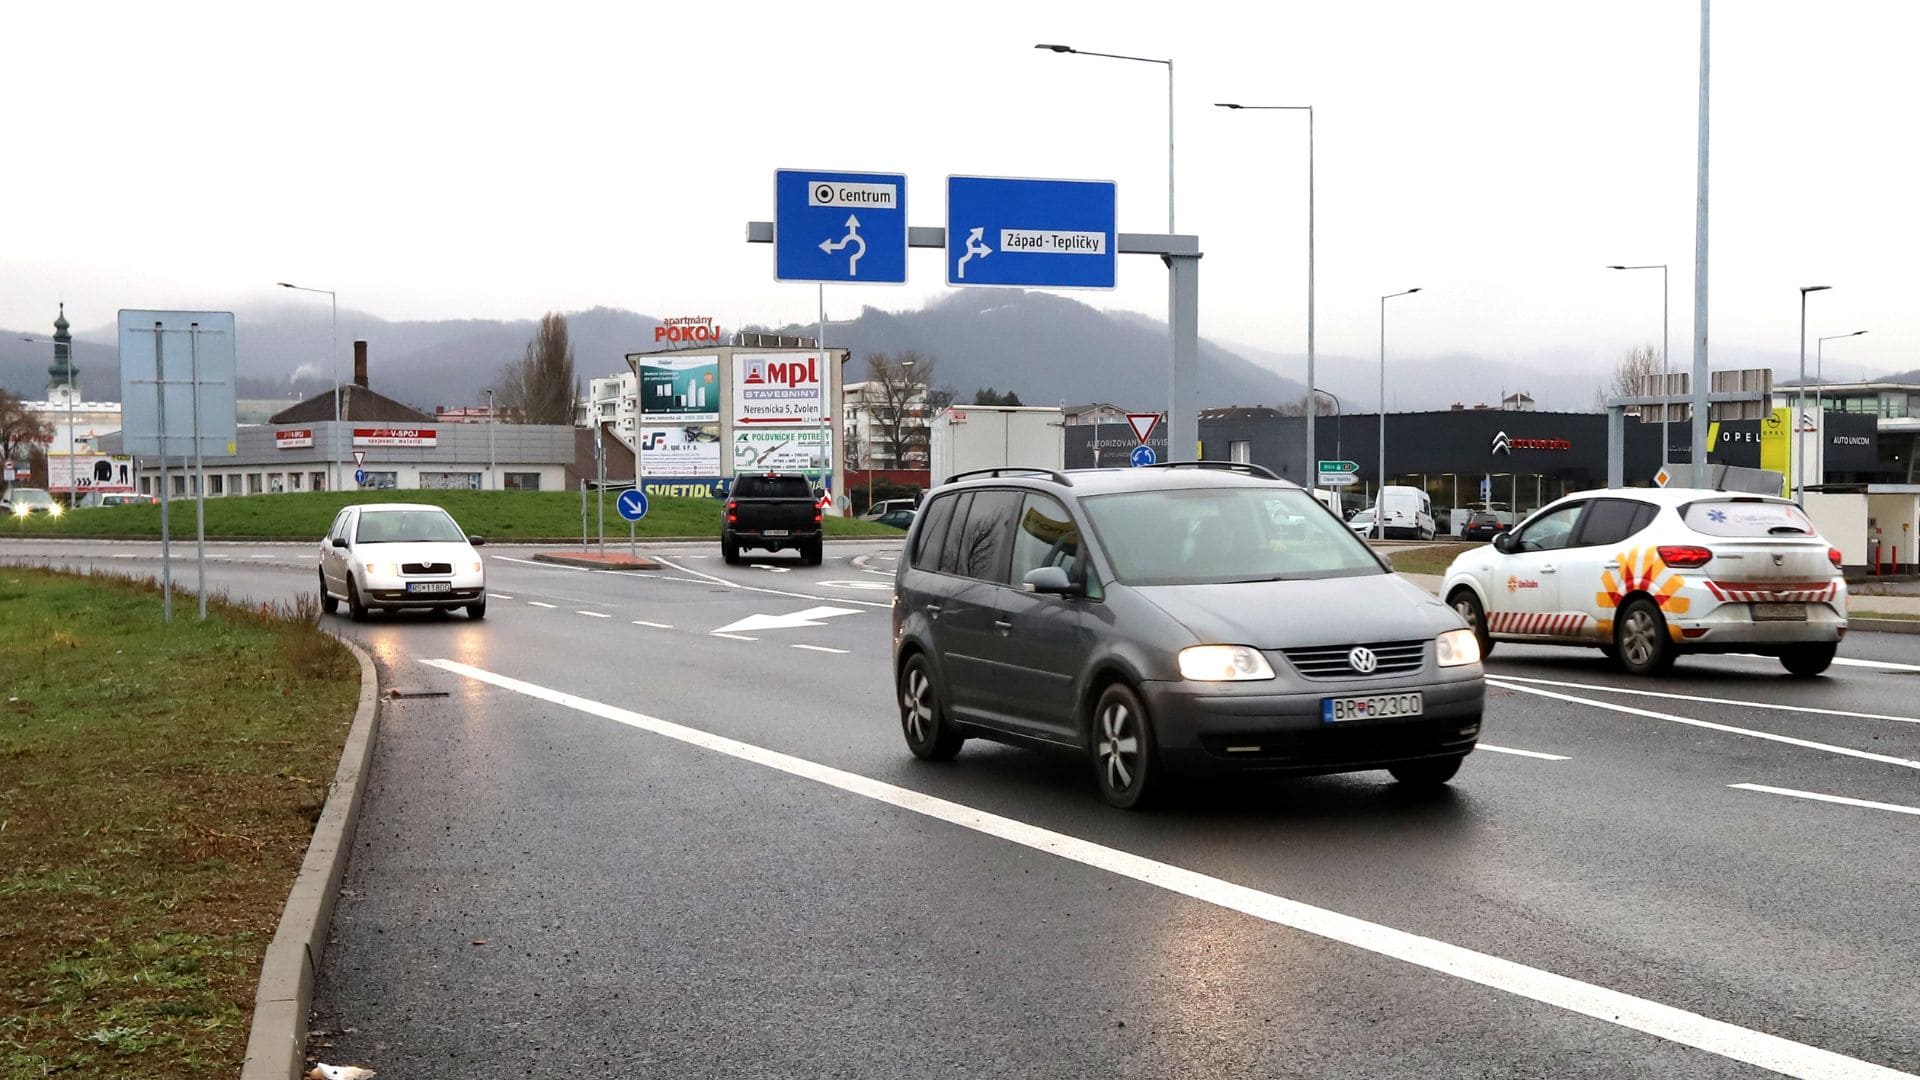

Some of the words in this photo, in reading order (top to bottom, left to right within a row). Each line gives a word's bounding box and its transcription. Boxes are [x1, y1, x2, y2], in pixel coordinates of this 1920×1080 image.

[839, 188, 891, 203] Centrum
[1007, 233, 1043, 250] Západ
[1052, 235, 1099, 252] Tepličky
[663, 315, 713, 327] apartmány
[655, 325, 721, 343] POKOJ
[745, 390, 817, 399] STAVEBNINY
[794, 403, 819, 414] Zvolen
[797, 432, 830, 441] POTREY
[1722, 431, 1761, 442] OPEL
[1833, 436, 1849, 445] AUTO
[1849, 437, 1870, 446] UNICOM
[1086, 438, 1141, 449] AUTORIZOVAN
[1145, 438, 1168, 447] ERVIS
